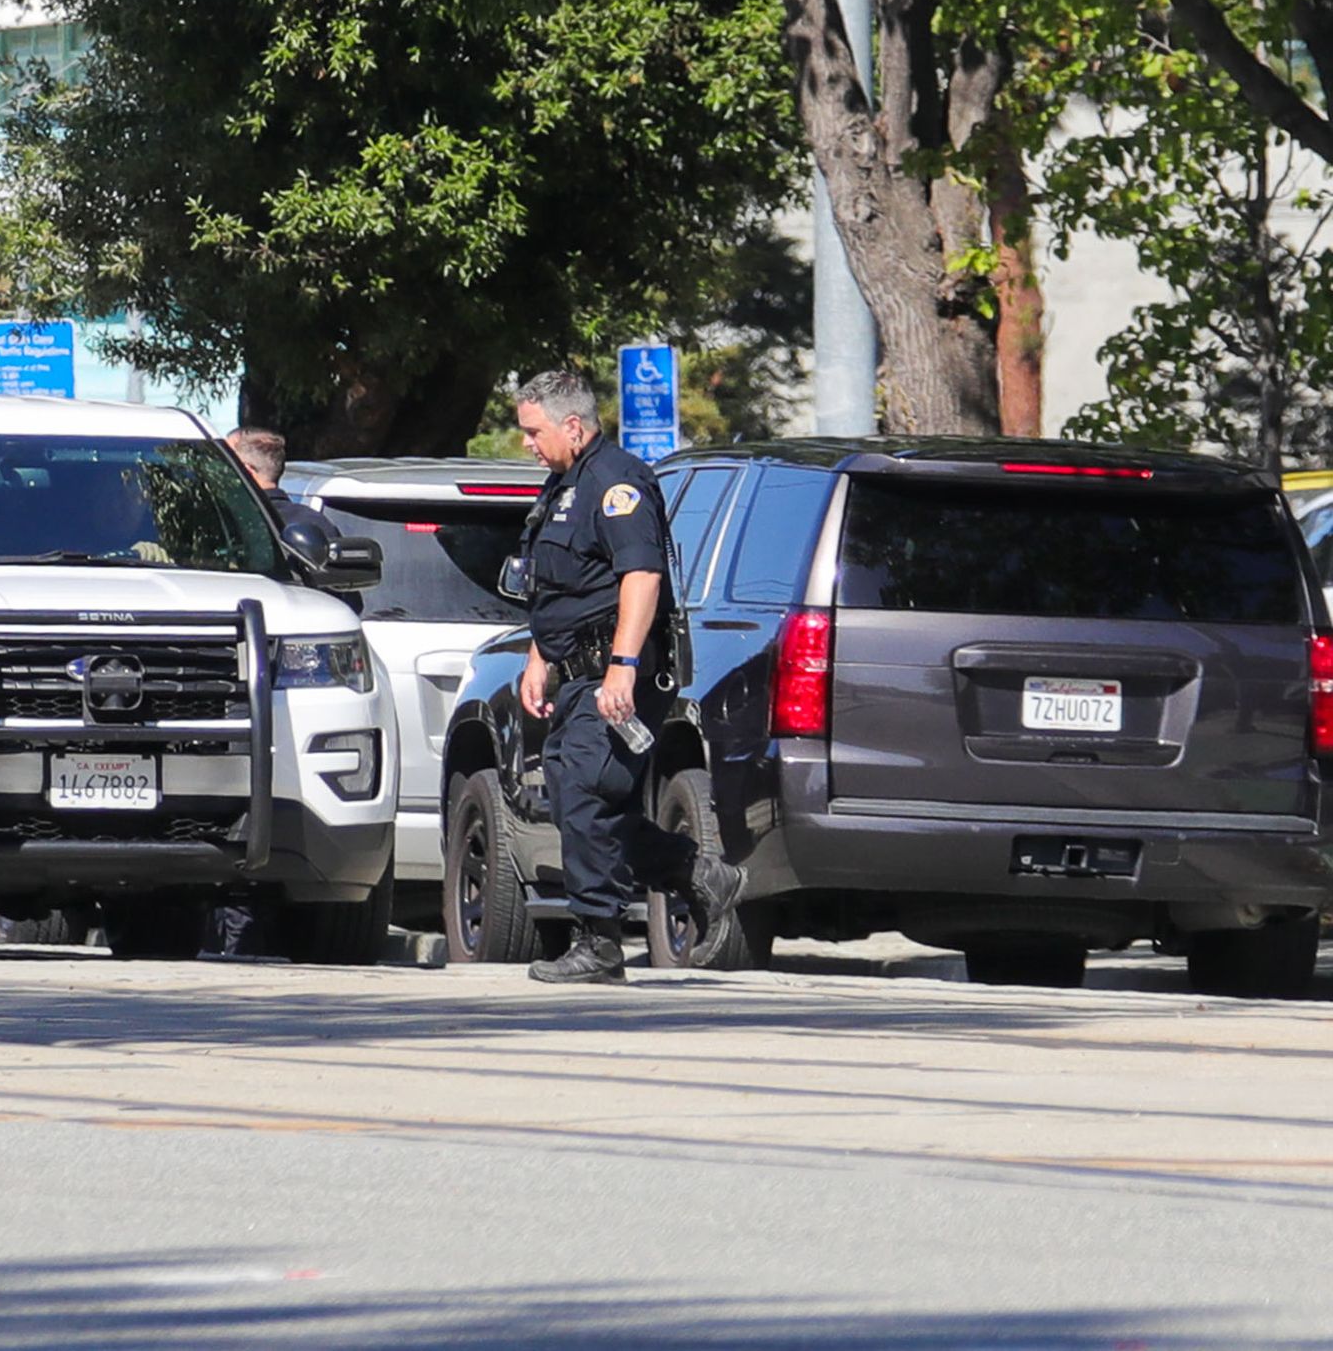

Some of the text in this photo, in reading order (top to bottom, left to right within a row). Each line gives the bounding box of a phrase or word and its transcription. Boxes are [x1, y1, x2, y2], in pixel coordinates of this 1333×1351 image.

[78, 612, 135, 622] SETINA
[1031, 697, 1114, 723] 7ZHU072
[76, 762, 131, 771] CA EXEMPT
[59, 773, 149, 800] 1467882
